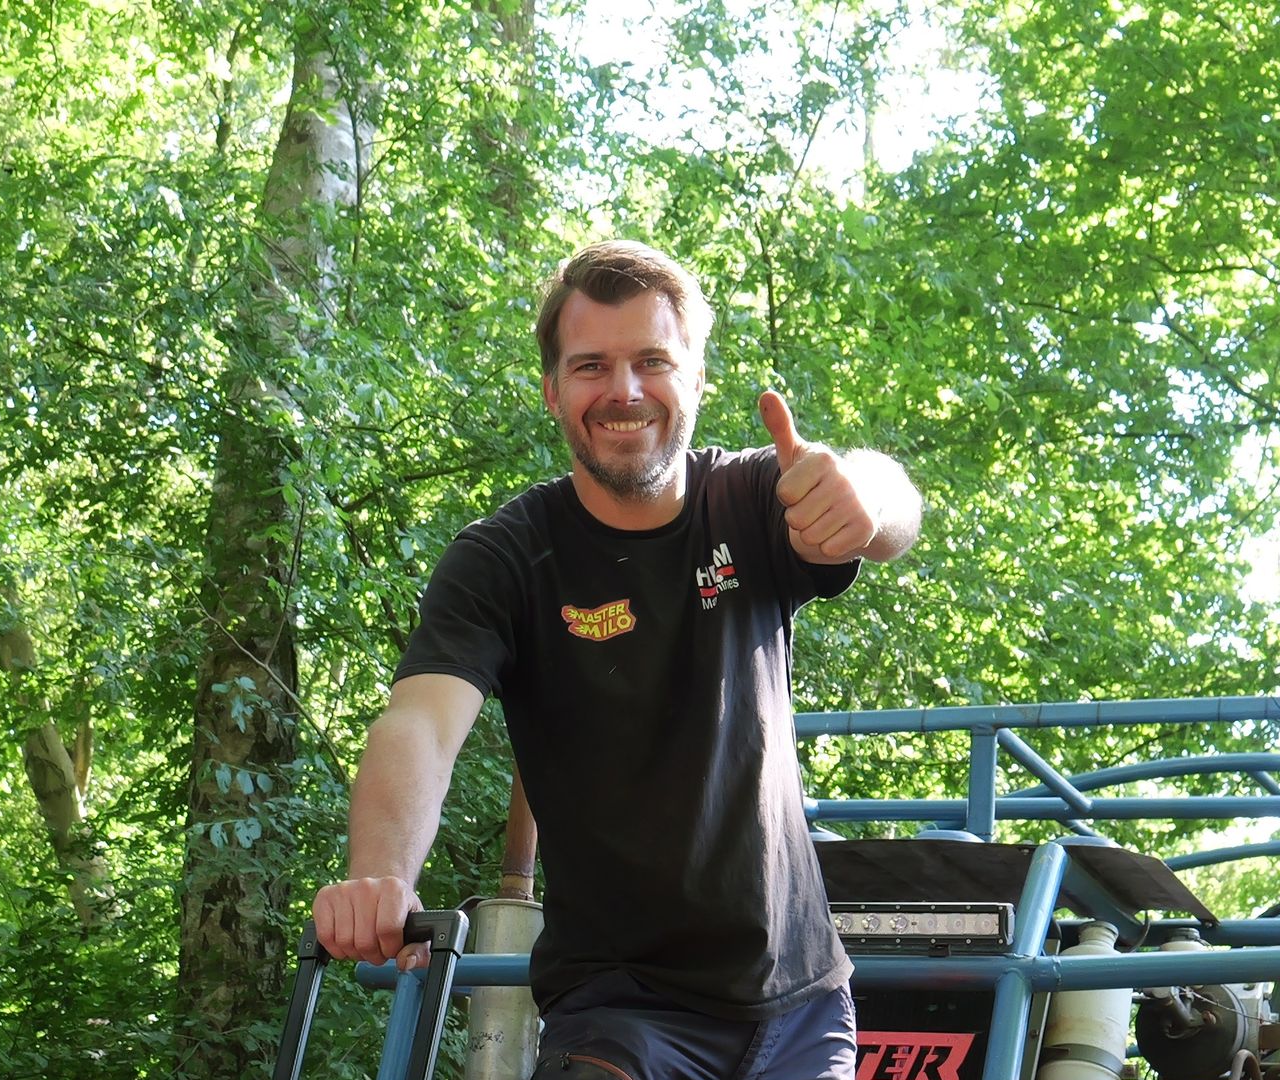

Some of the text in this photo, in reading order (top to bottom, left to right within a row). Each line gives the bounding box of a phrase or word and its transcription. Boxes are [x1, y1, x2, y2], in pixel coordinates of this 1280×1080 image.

[696, 543, 733, 587] HM
[567, 603, 625, 623] MASTER
[576, 615, 631, 638] MILO
